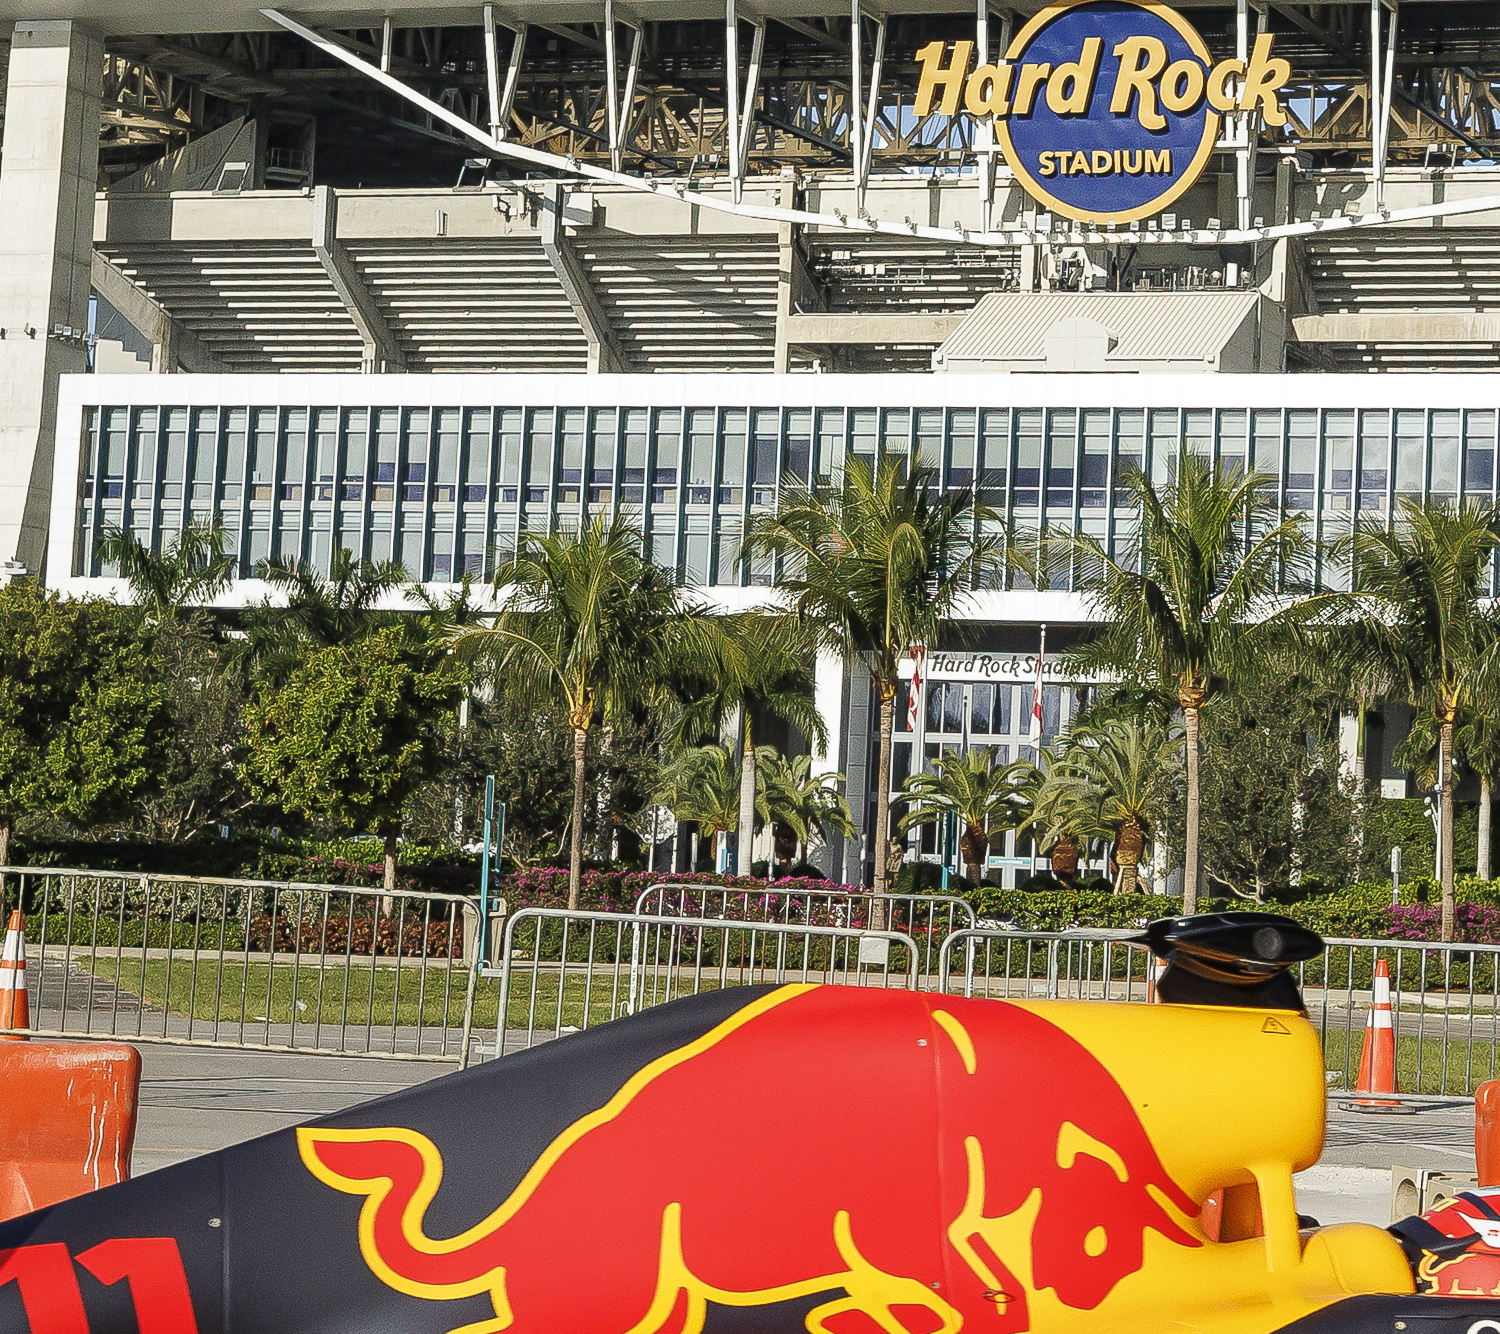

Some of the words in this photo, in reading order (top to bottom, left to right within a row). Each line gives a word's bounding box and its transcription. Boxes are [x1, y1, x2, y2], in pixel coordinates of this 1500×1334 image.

[912, 37, 1105, 119] Hard
[1109, 32, 1292, 131] Rock
[1038, 148, 1172, 177] STADIUM
[931, 653, 977, 674] Hard
[979, 654, 1020, 678] Rock
